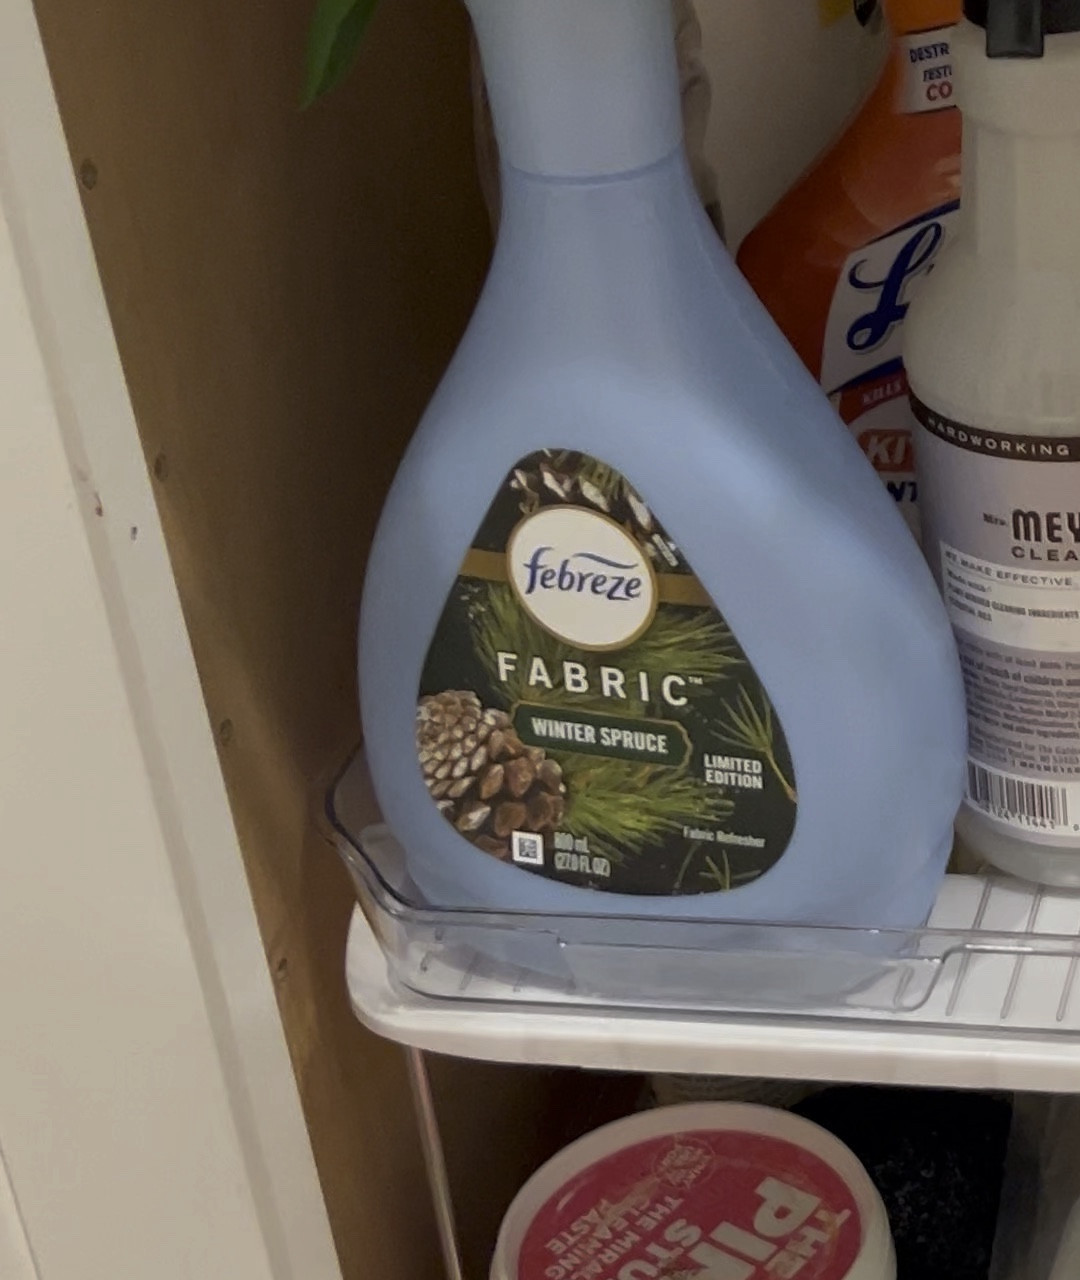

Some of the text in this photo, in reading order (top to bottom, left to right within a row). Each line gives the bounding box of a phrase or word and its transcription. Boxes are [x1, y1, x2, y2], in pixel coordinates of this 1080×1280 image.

[909, 42, 950, 63] DESTR
[923, 65, 953, 81] TEST
[926, 81, 953, 101] CO
[866, 434, 907, 465] KI
[929, 417, 1070, 456] HARDWORKING
[524, 546, 642, 601] febreze
[531, 717, 669, 754] WINTER SPRUCE
[703, 752, 762, 774] LIMITED
[705, 770, 764, 790] EDITION
[637, 1195, 685, 1232] THE
